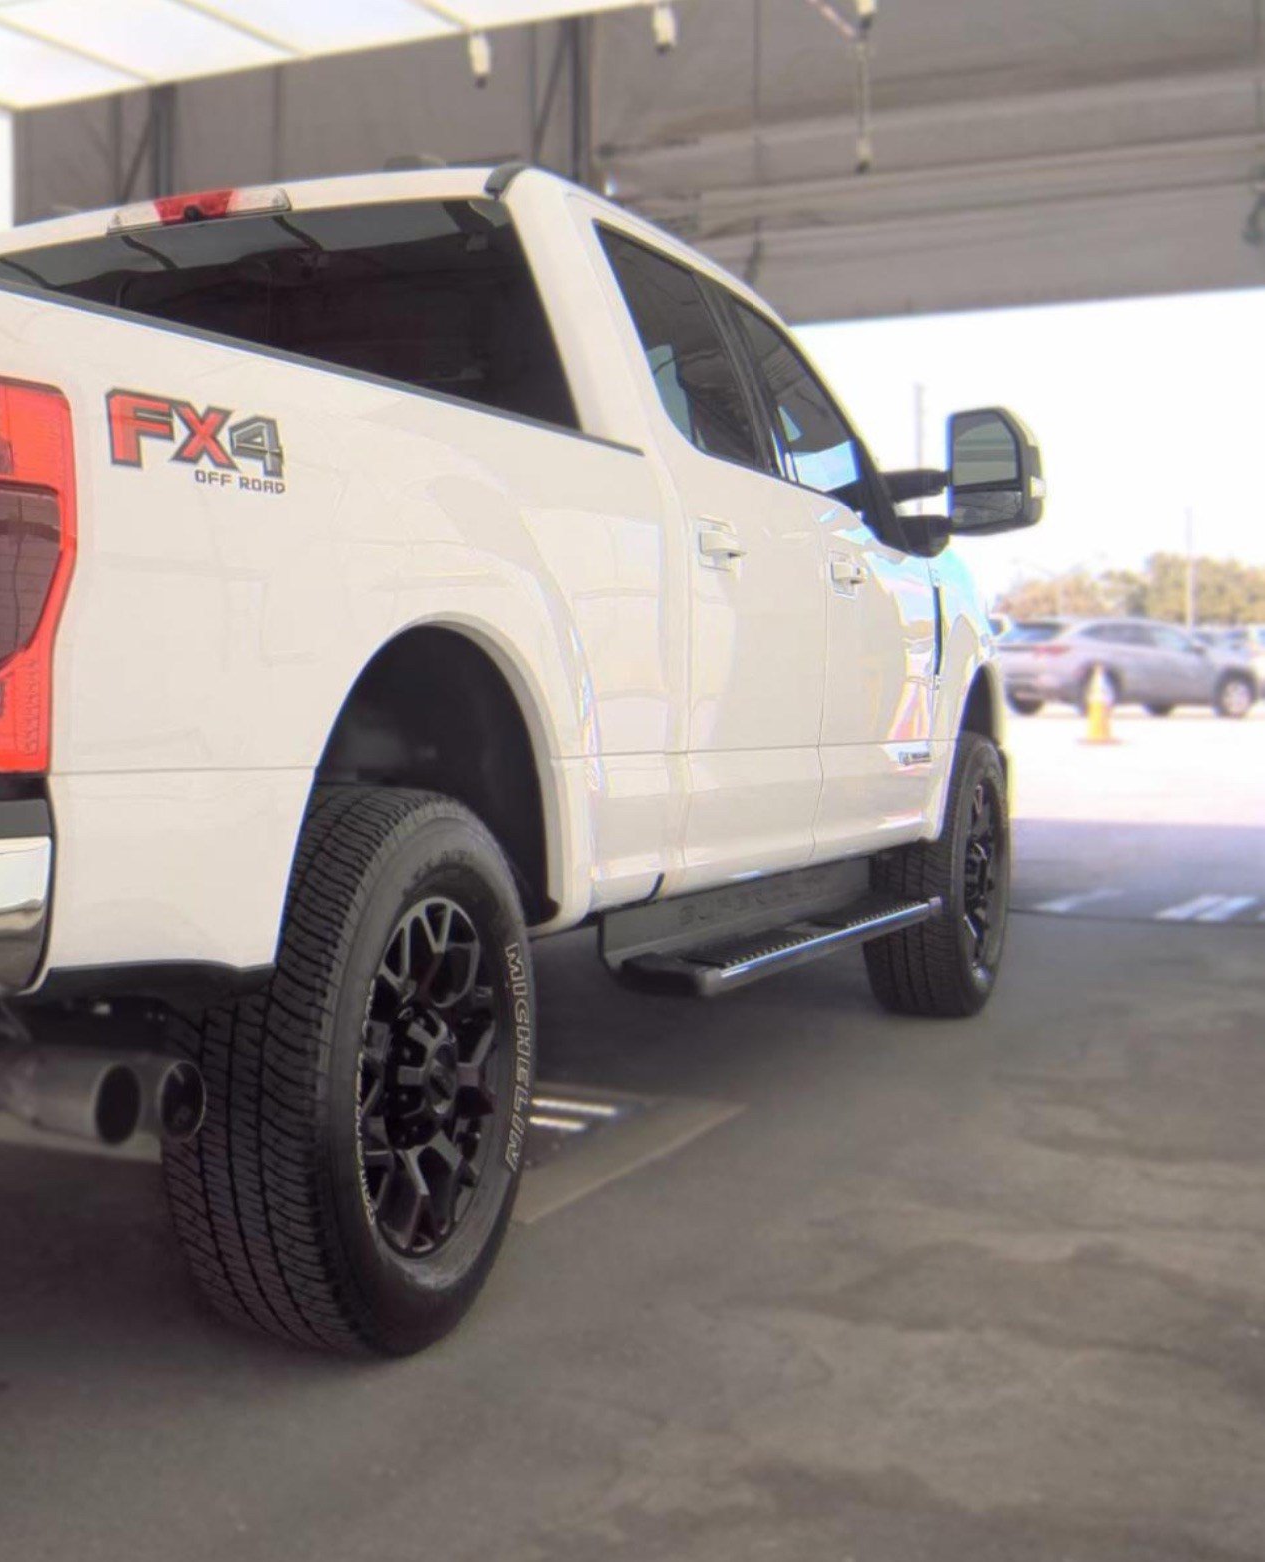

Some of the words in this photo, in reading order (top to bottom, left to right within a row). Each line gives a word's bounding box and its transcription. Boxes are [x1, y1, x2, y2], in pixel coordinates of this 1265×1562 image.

[105, 388, 284, 478] FX4
[194, 469, 232, 486] OFF
[239, 476, 285, 495] ROAD
[505, 942, 531, 1172] MICHELIN
